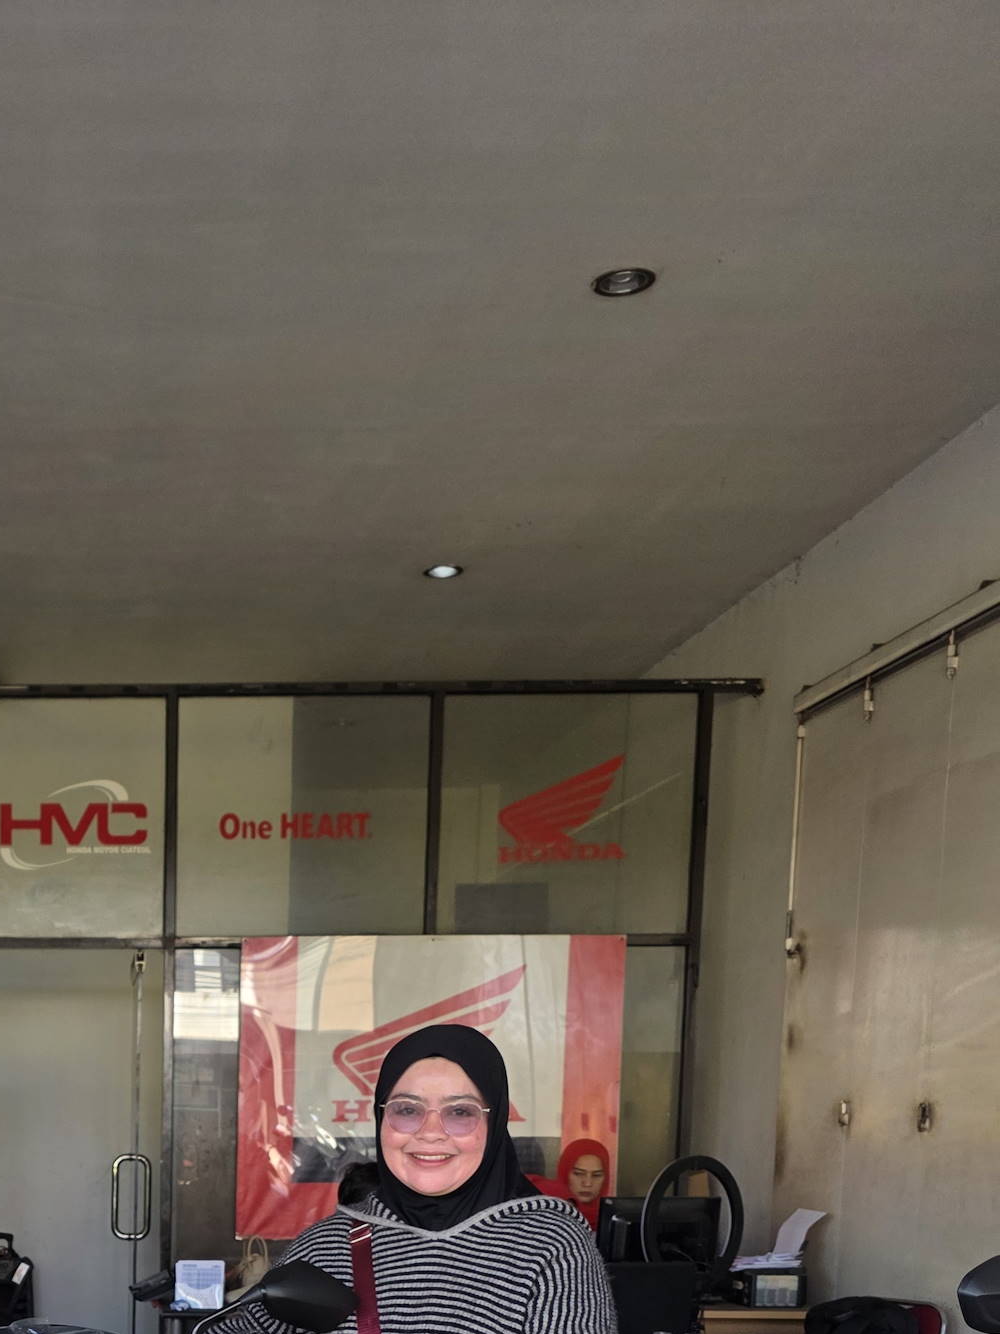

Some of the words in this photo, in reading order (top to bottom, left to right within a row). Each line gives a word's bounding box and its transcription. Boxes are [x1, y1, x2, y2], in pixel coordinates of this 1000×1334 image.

[0, 803, 148, 845] HMC
[219, 812, 272, 839] One
[280, 812, 373, 839] HEART.
[497, 841, 625, 863] HONDA
